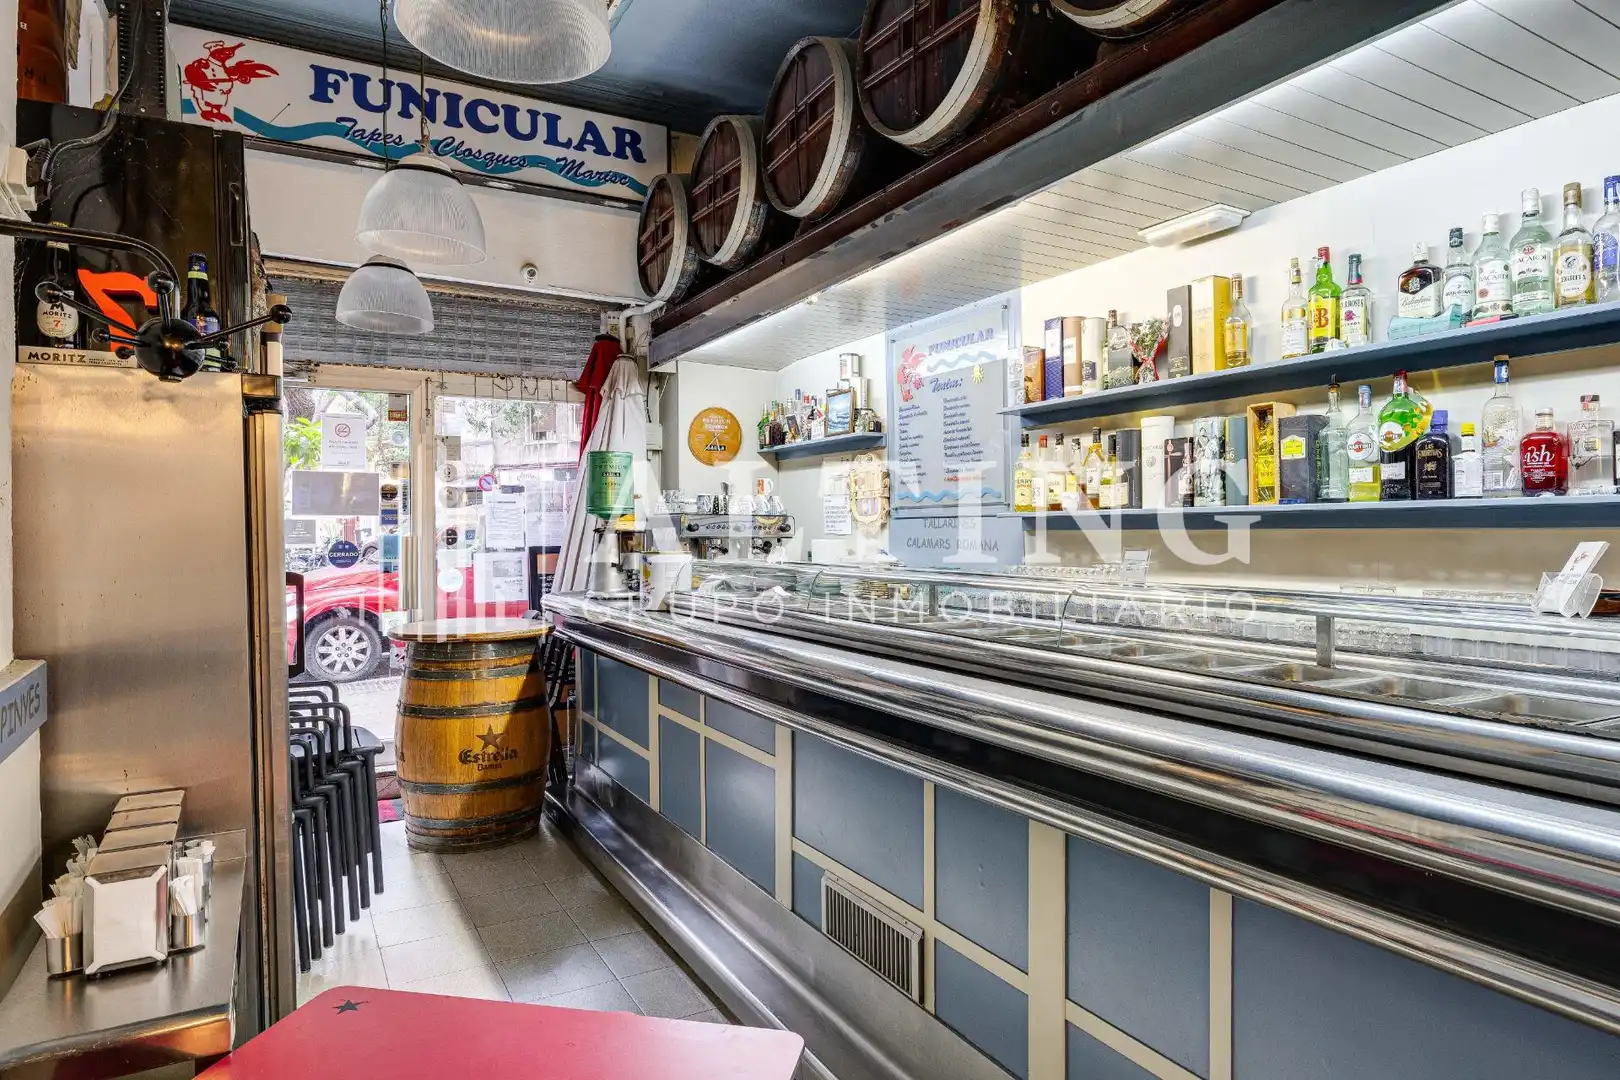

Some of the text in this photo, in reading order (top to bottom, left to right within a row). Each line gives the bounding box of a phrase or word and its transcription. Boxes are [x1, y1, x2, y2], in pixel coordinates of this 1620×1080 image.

[309, 64, 647, 163] FUNICULAR
[335, 117, 405, 147] Tapes
[434, 136, 528, 167] Closques
[556, 156, 630, 186] Marisc
[42, 310, 72, 319] MORITZ
[928, 327, 994, 356] FUNICULAR
[27, 351, 87, 364] MORITZ
[1524, 444, 1555, 463] ish
[906, 536, 999, 552] CALAMARS ROMANA
[0, 682, 41, 744] PINYES
[458, 747, 518, 765] Estrella
